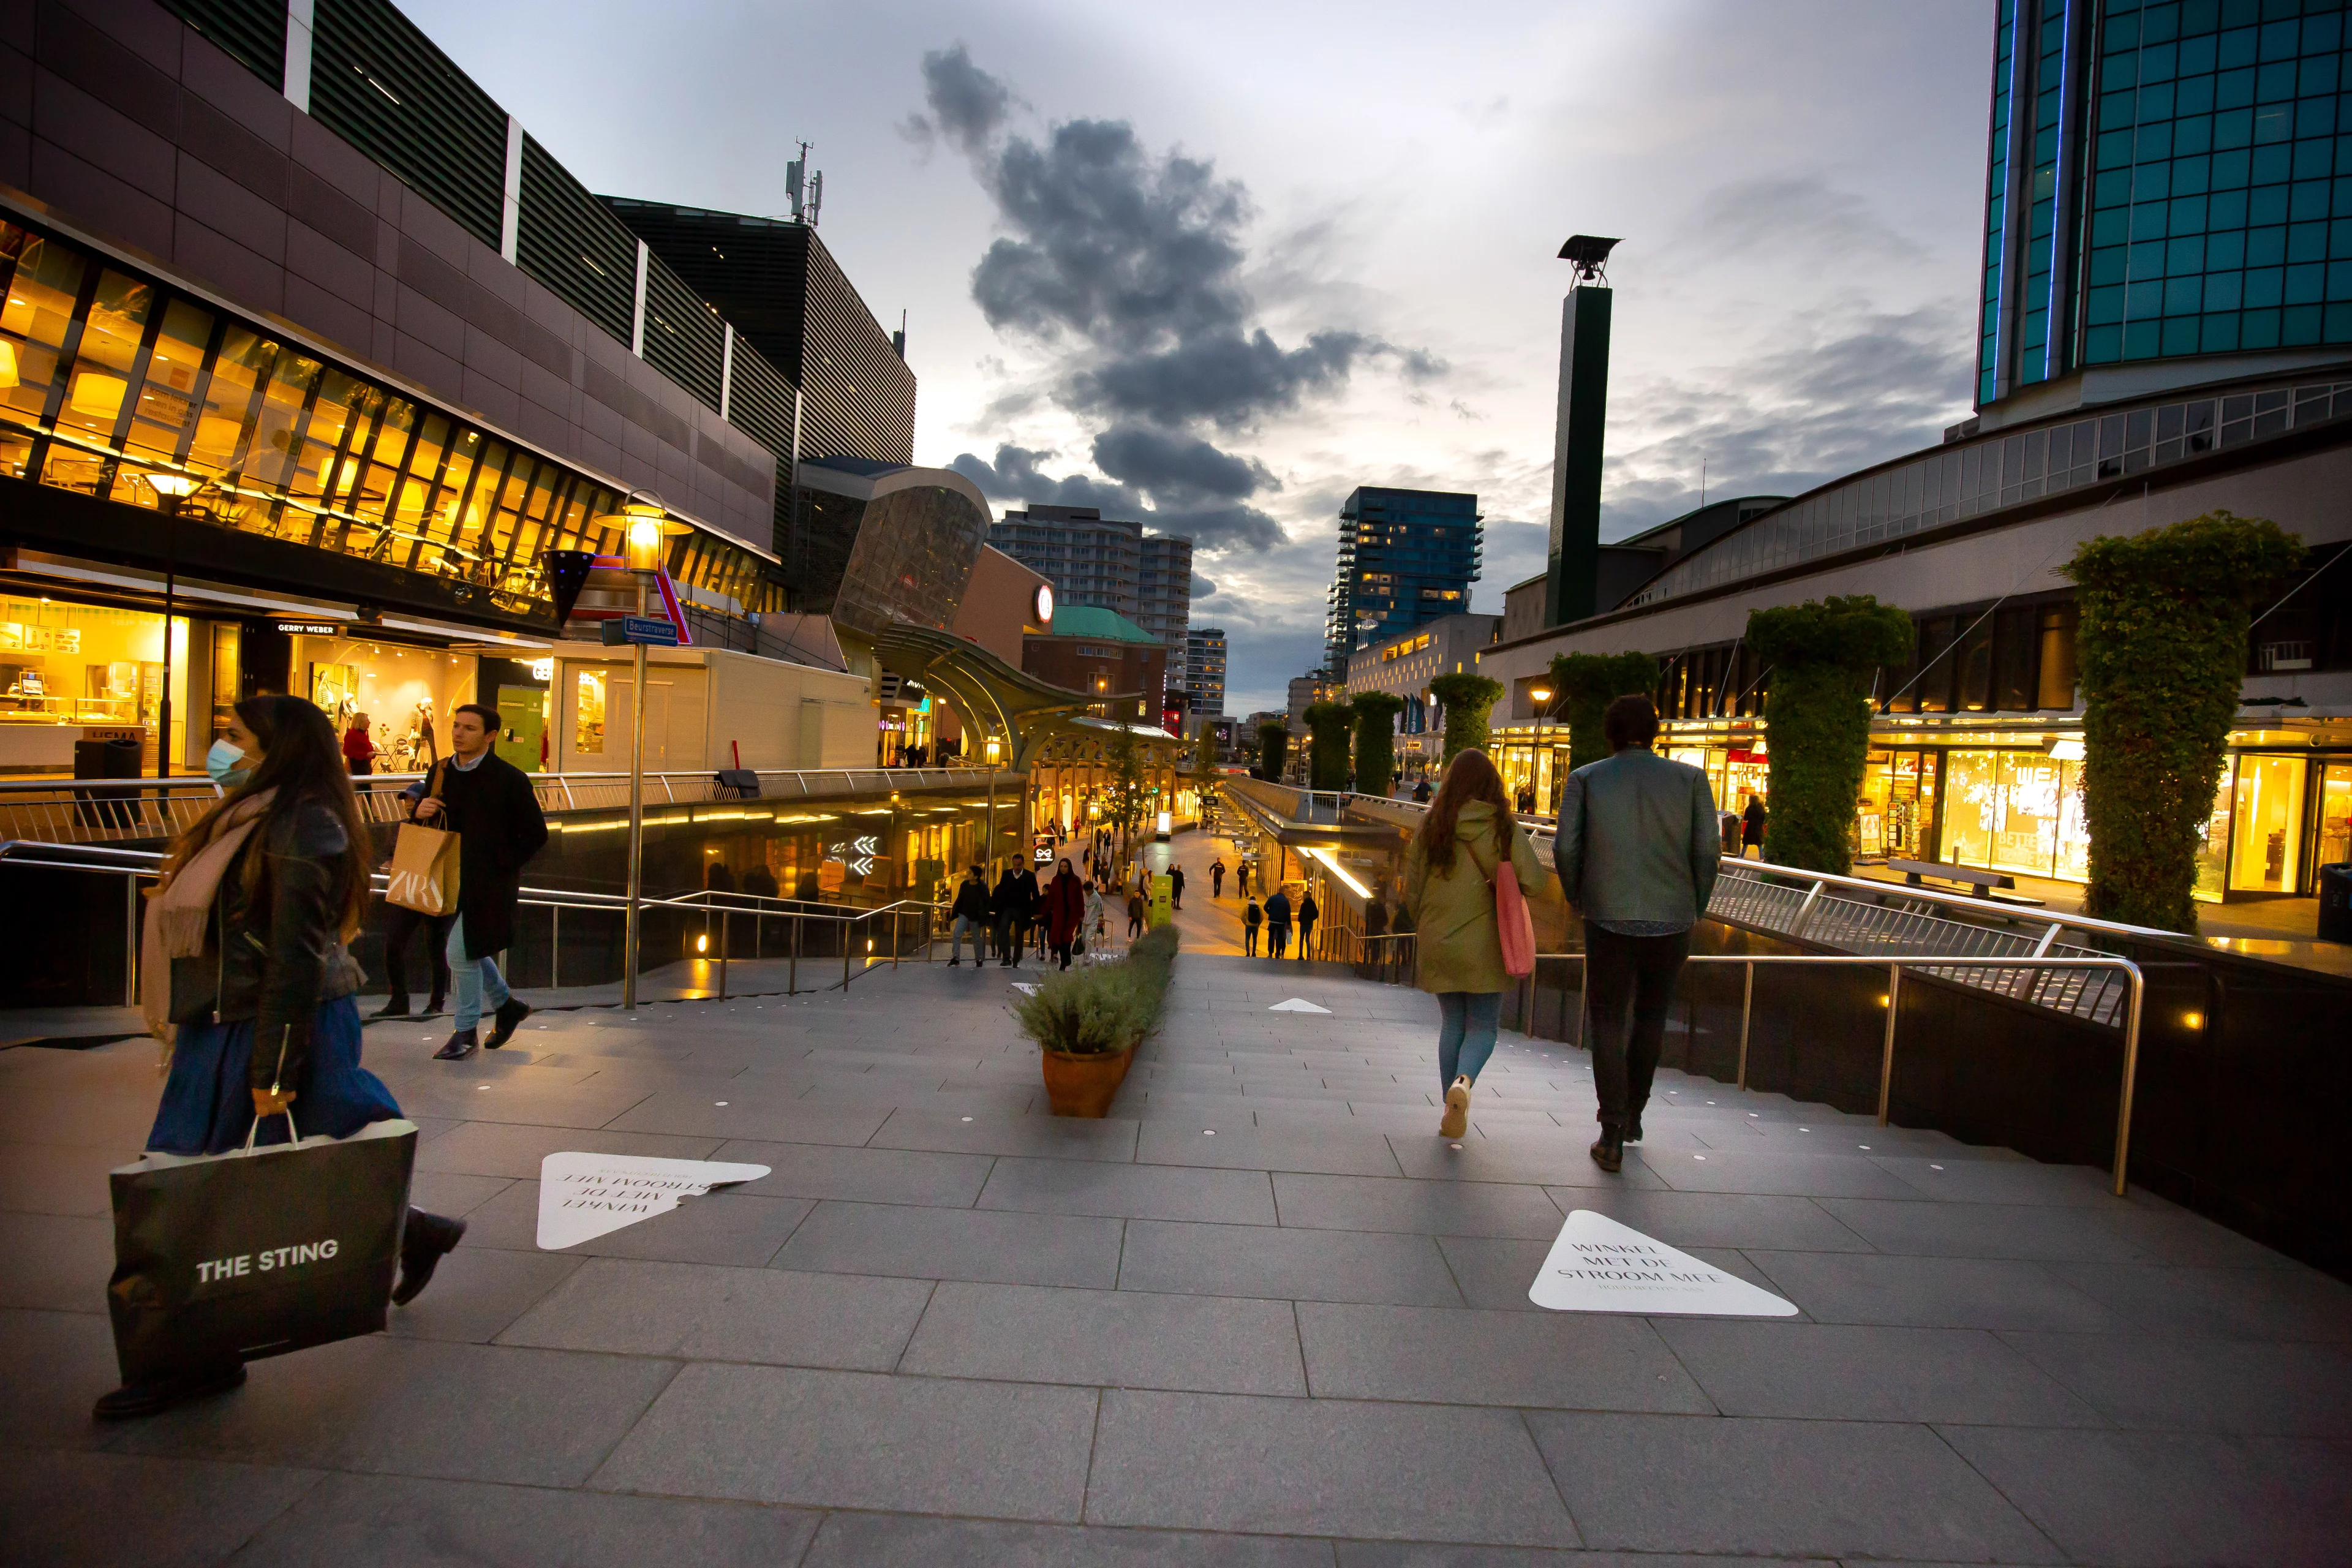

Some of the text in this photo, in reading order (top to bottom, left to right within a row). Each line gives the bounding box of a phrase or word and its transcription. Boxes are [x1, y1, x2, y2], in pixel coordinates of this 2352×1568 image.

[143, 407, 190, 427] restaurant
[629, 620, 674, 635] Beurstraverse
[92, 731, 136, 741] HEMA
[2016, 766, 2052, 785] WE
[556, 1174, 710, 1191] STROOM MEE
[573, 1188, 665, 1200] MET DE
[562, 1199, 647, 1212] WINKEL
[1571, 1243, 1664, 1254] WINKEL
[196, 1239, 338, 1283] THE STING
[1581, 1256, 1674, 1268] MET DE
[1558, 1269, 1725, 1283] STROOM MEE
